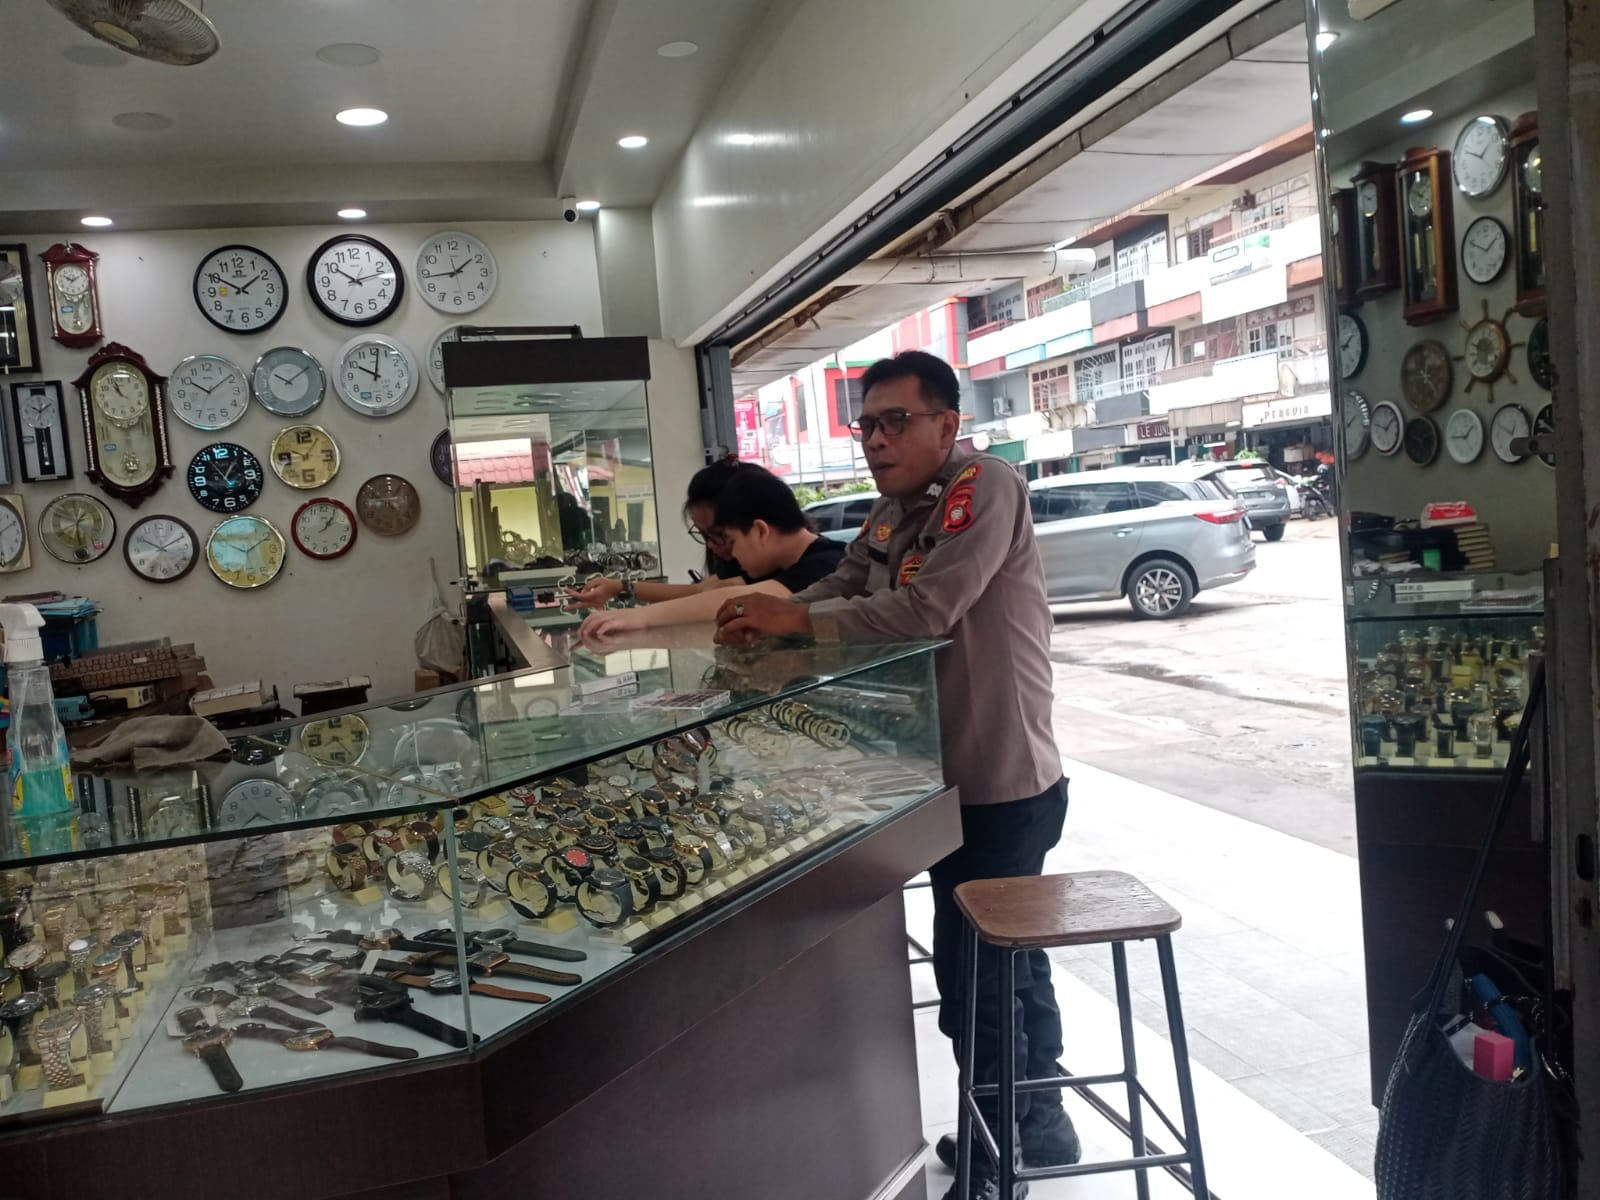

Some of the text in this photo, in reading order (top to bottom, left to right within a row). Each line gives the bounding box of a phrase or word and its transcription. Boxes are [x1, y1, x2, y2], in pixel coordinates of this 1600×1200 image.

[434, 244, 442, 254] 11
[447, 241, 459, 250] 12
[467, 244, 471, 253] 1
[335, 252, 345, 263] 11
[346, 248, 360, 260] 12
[365, 251, 371, 263] 1
[474, 254, 483, 264] 2
[231, 257, 244, 268] 12
[425, 255, 437, 264] 10
[219, 262, 229, 272] 11
[250, 260, 255, 270] 1
[325, 262, 339, 274] 10
[375, 261, 384, 273] 2
[261, 269, 269, 280] 2
[421, 269, 431, 279] 9
[480, 268, 488, 277] 3
[208, 273, 220, 284] 10
[321, 276, 331, 288] 9
[266, 283, 275, 294] 3
[428, 283, 436, 292] 8
[477, 281, 484, 290] 4
[208, 287, 216, 297] 9
[327, 289, 337, 301] 8
[378, 288, 387, 300] 4
[439, 292, 447, 302] 7
[467, 291, 476, 301] 5
[214, 300, 222, 311] 8
[265, 297, 272, 307] 4
[340, 299, 349, 311] 7
[368, 299, 377, 310] 5
[453, 296, 462, 306] 6
[255, 308, 264, 318] 5
[354, 303, 364, 314] 6
[226, 309, 234, 320] 7
[241, 312, 249, 323] 6
[358, 351, 366, 359] 11
[201, 362, 212, 371] 12
[349, 361, 359, 369] 10
[393, 359, 400, 367] 2
[191, 368, 198, 376] 11
[347, 372, 354, 380] 9
[397, 370, 404, 378] 3
[181, 377, 193, 385] 10
[228, 374, 236, 384] 2
[232, 387, 240, 396] 3
[353, 384, 360, 393] 8
[177, 389, 186, 399] 9
[375, 394, 382, 403] 6
[387, 391, 394, 399] 5
[184, 401, 192, 410] 8
[230, 399, 238, 408] 4
[196, 409, 202, 419] 7
[220, 408, 229, 417] 5
[208, 413, 216, 423] 6
[1140, 425, 1151, 438] LE
[295, 431, 313, 444] 12
[212, 448, 229, 459] 12
[278, 452, 292, 465] 9
[321, 449, 334, 462] 3
[243, 457, 252, 466] 2
[192, 465, 206, 473] 10
[244, 469, 257, 480] 3
[194, 476, 207, 487] 9
[224, 497, 236, 508] 6
